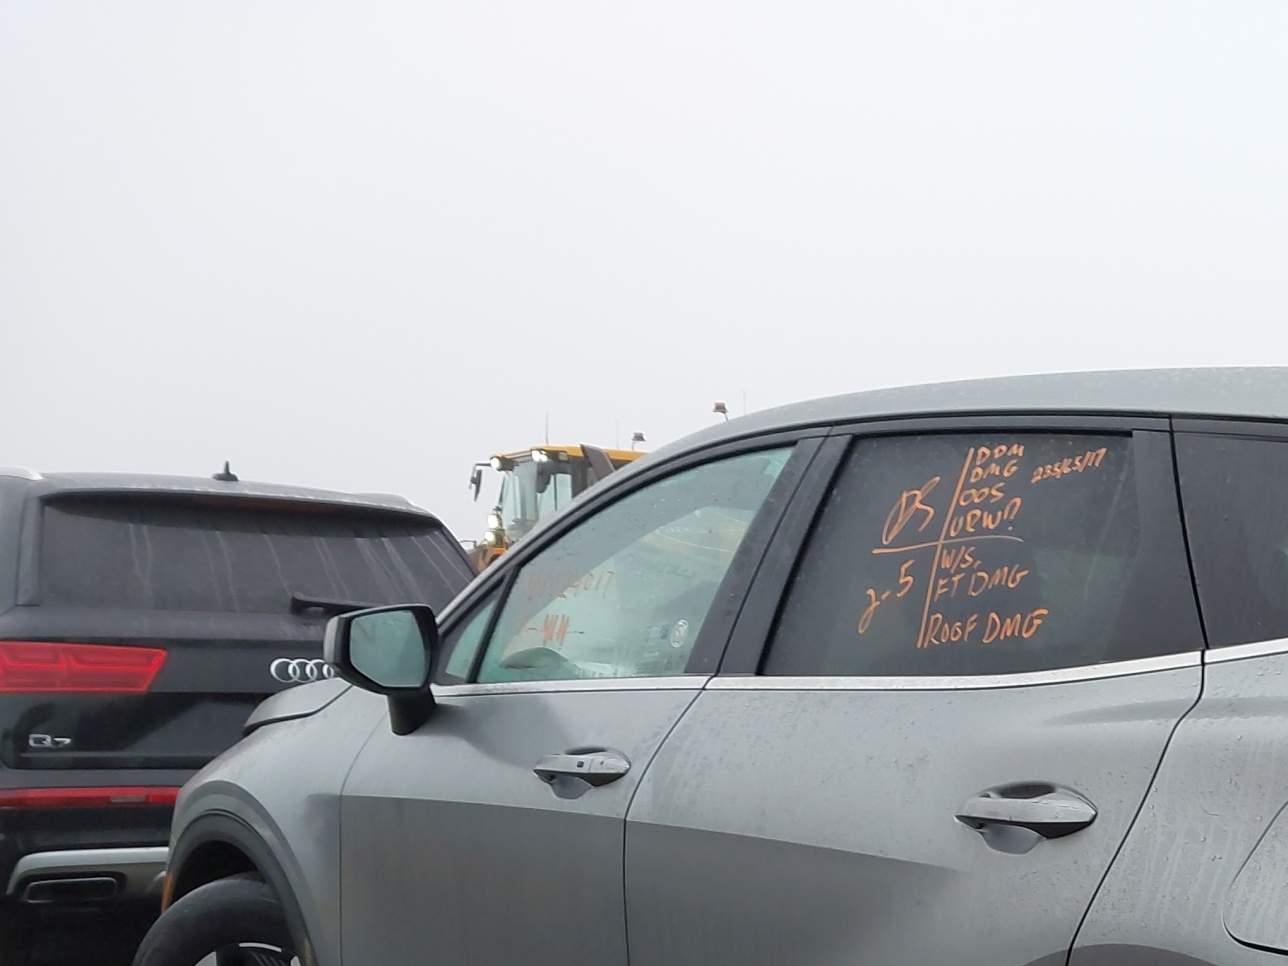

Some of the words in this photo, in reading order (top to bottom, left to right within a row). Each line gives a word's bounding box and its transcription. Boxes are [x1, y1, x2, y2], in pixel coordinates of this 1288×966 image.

[967, 564, 1030, 597] DMG
[981, 608, 1049, 644] DMG
[29, 733, 71, 748] Q7
